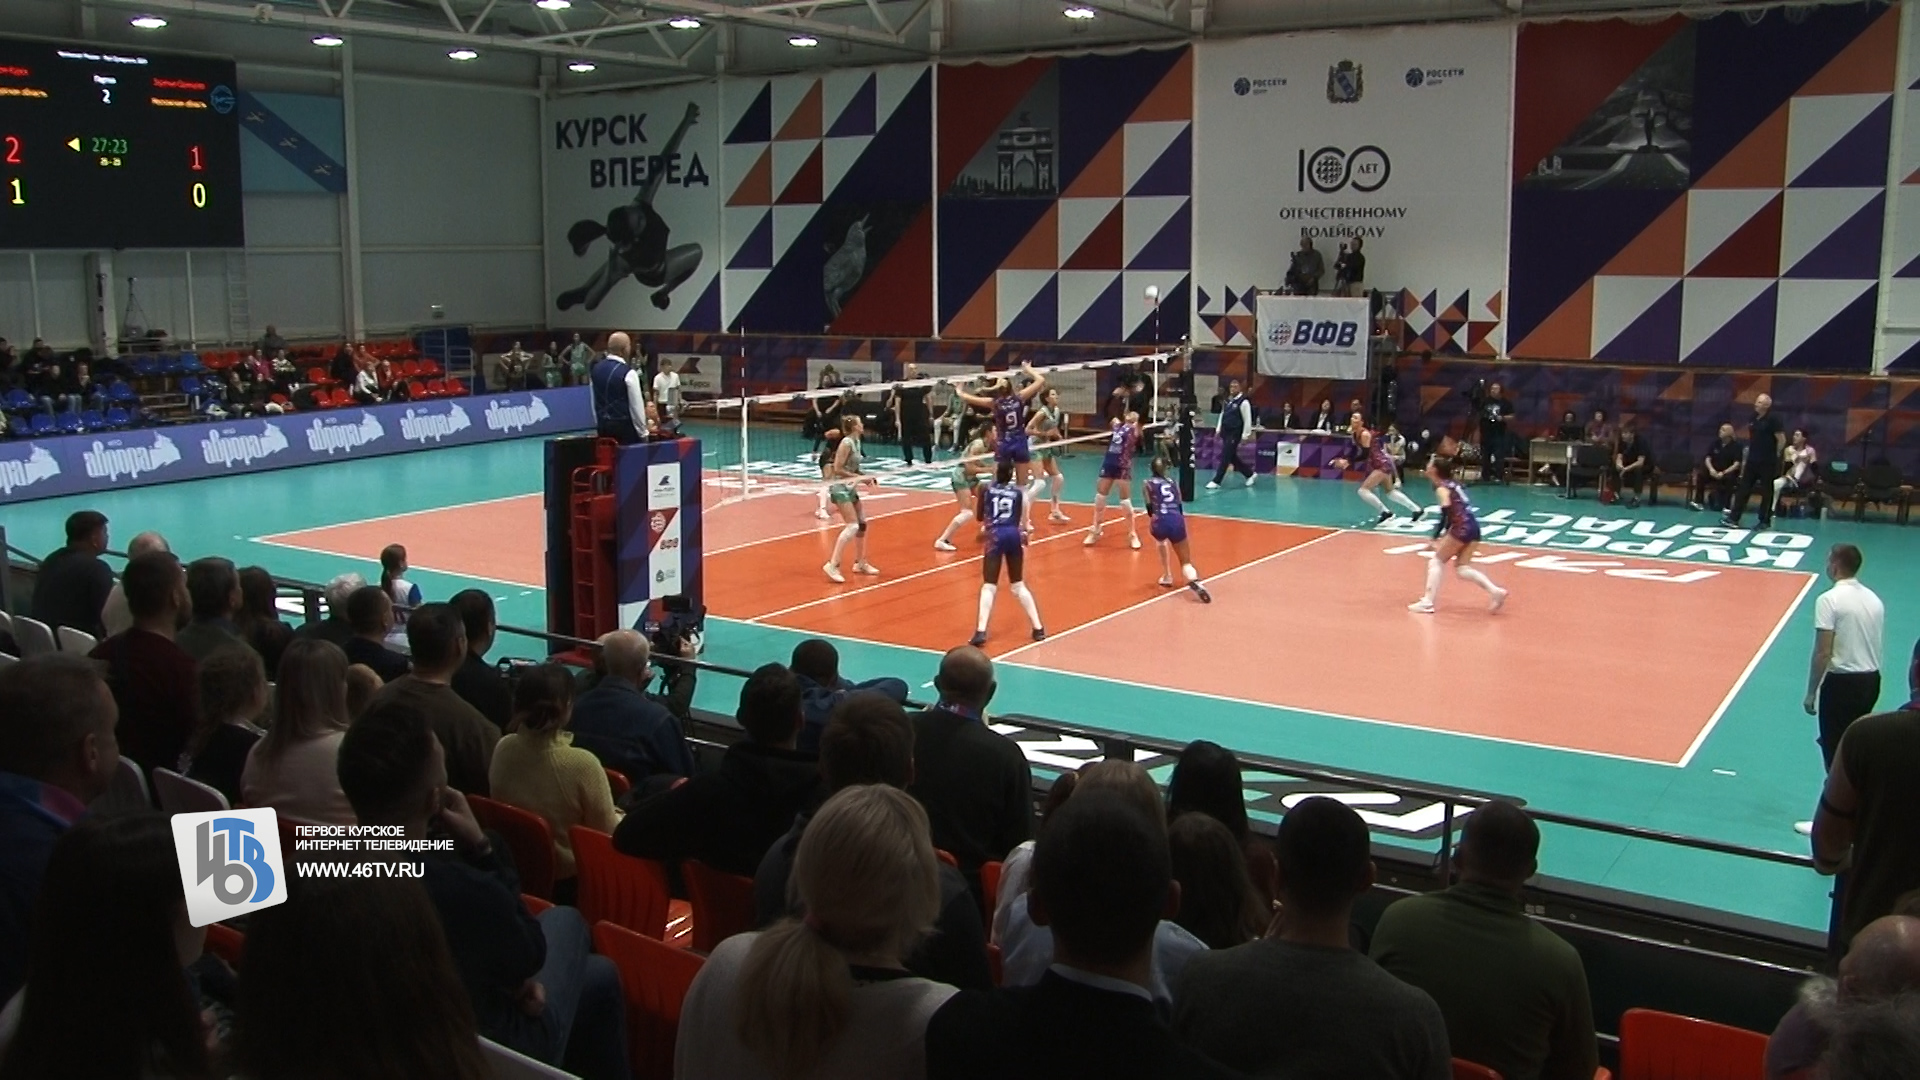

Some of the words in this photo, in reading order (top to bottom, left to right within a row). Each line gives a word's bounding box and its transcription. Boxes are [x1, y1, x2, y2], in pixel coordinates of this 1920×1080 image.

[1426, 67, 1464, 78] РОССЕТИ
[102, 88, 111, 104] 2
[556, 113, 648, 149] КУРСК
[5, 136, 21, 164] 2
[92, 137, 128, 154] 27:23
[191, 145, 202, 170] 1
[590, 152, 709, 188] ВПЕРЕД
[1357, 163, 1379, 174] ЛЕТ
[10, 177, 25, 205] 1
[192, 182, 207, 208] 0
[1279, 207, 1407, 220] ОТЕЧЕСТВЕННОМУ
[1301, 224, 1385, 239] ВОЛЕЙБОЛУ
[1292, 319, 1358, 347] ВФВ
[1005, 411, 1018, 430] 9
[1161, 484, 1174, 502] 5
[992, 497, 1014, 518] 19
